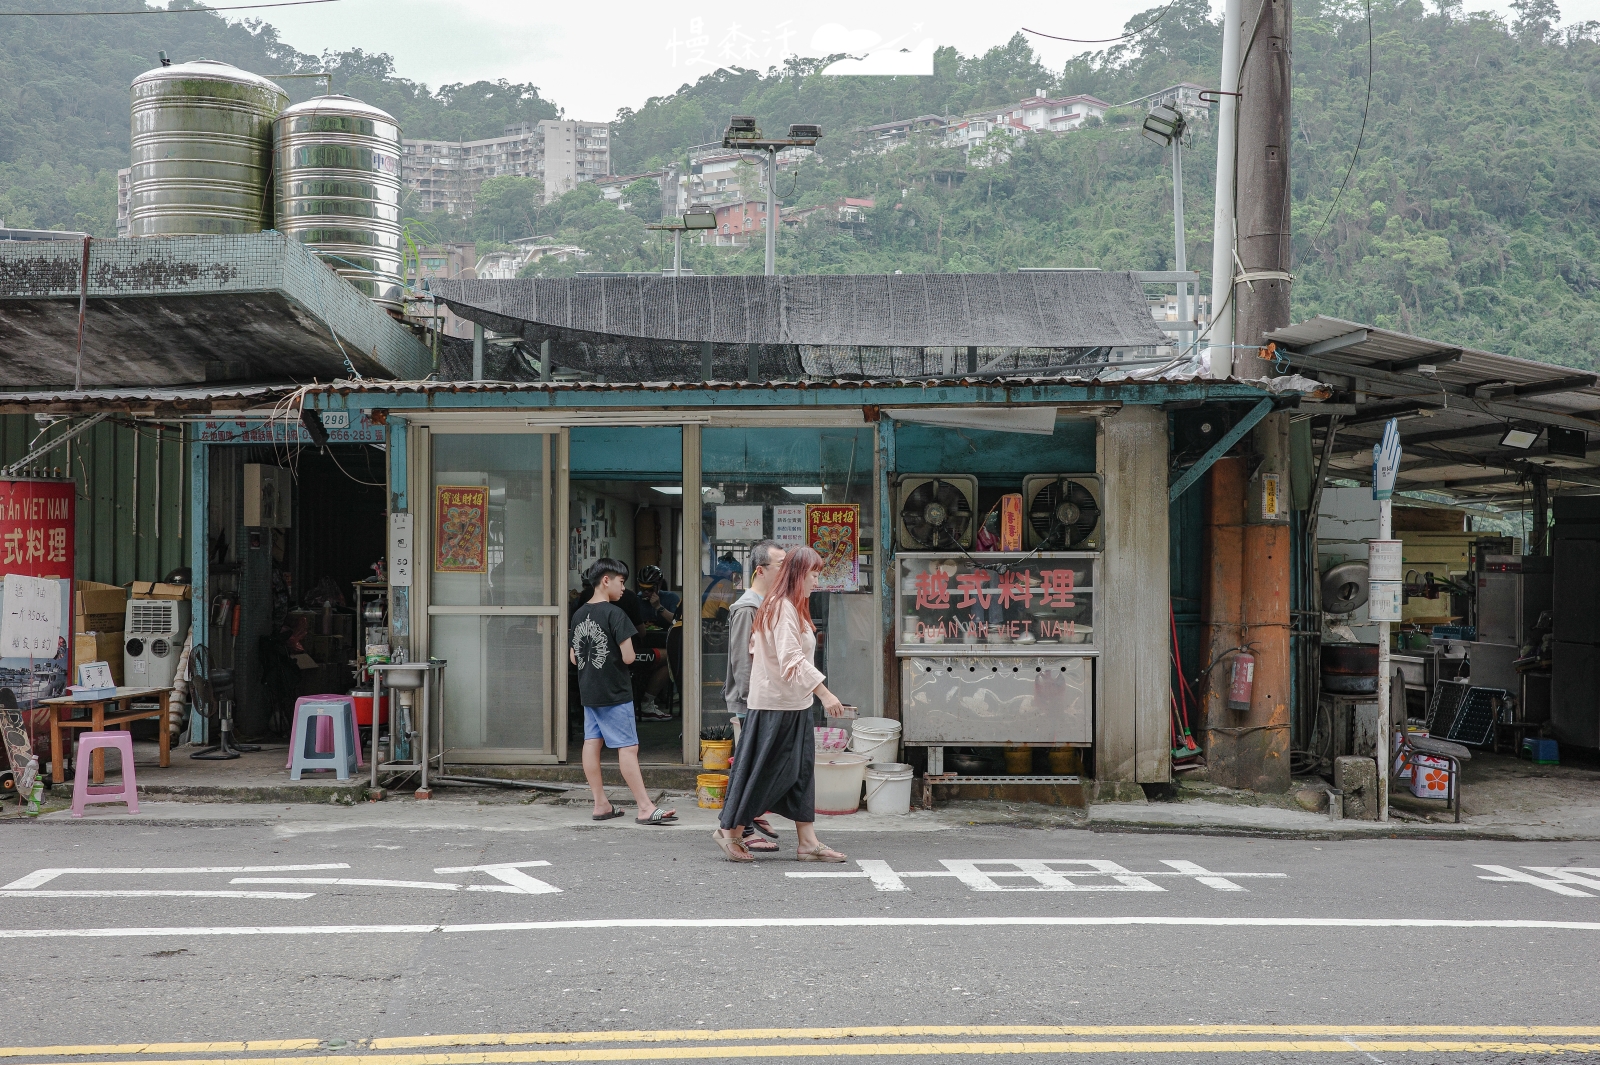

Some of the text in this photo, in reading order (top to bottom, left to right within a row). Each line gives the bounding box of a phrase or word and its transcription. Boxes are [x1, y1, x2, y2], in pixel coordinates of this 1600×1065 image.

[324, 415, 344, 425] 298
[47, 498, 69, 519] NAM
[718, 518, 761, 527] 每週一公休
[0, 527, 67, 565] 式料理
[915, 569, 1076, 610] 越式料理
[1040, 620, 1075, 638] NAM
